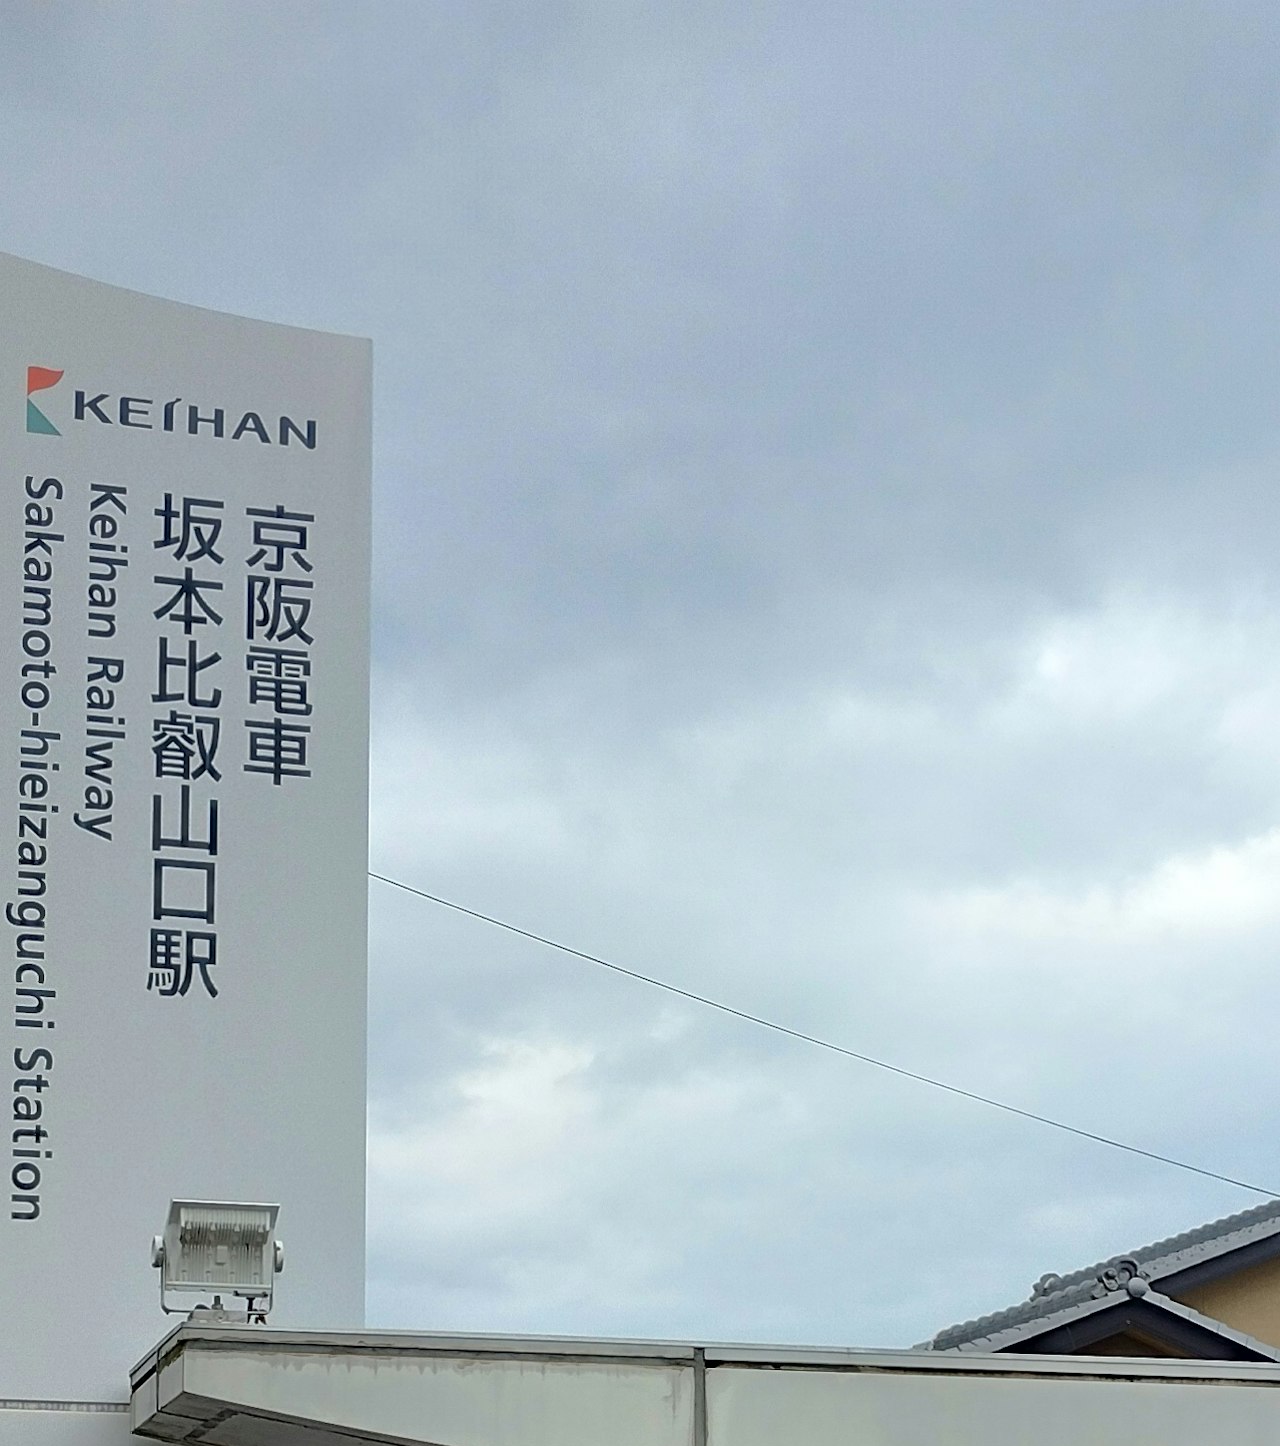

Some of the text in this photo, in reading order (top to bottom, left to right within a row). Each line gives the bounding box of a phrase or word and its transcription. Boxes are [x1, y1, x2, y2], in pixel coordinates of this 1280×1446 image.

[73, 390, 318, 450] KEIHAN
[73, 482, 129, 842] Keihan Railway
[146, 492, 225, 999] 坂本比叡山口駅
[243, 504, 316, 786] 京阪電車
[5, 475, 65, 1222] Sakamoto-hieizanguchi Station
